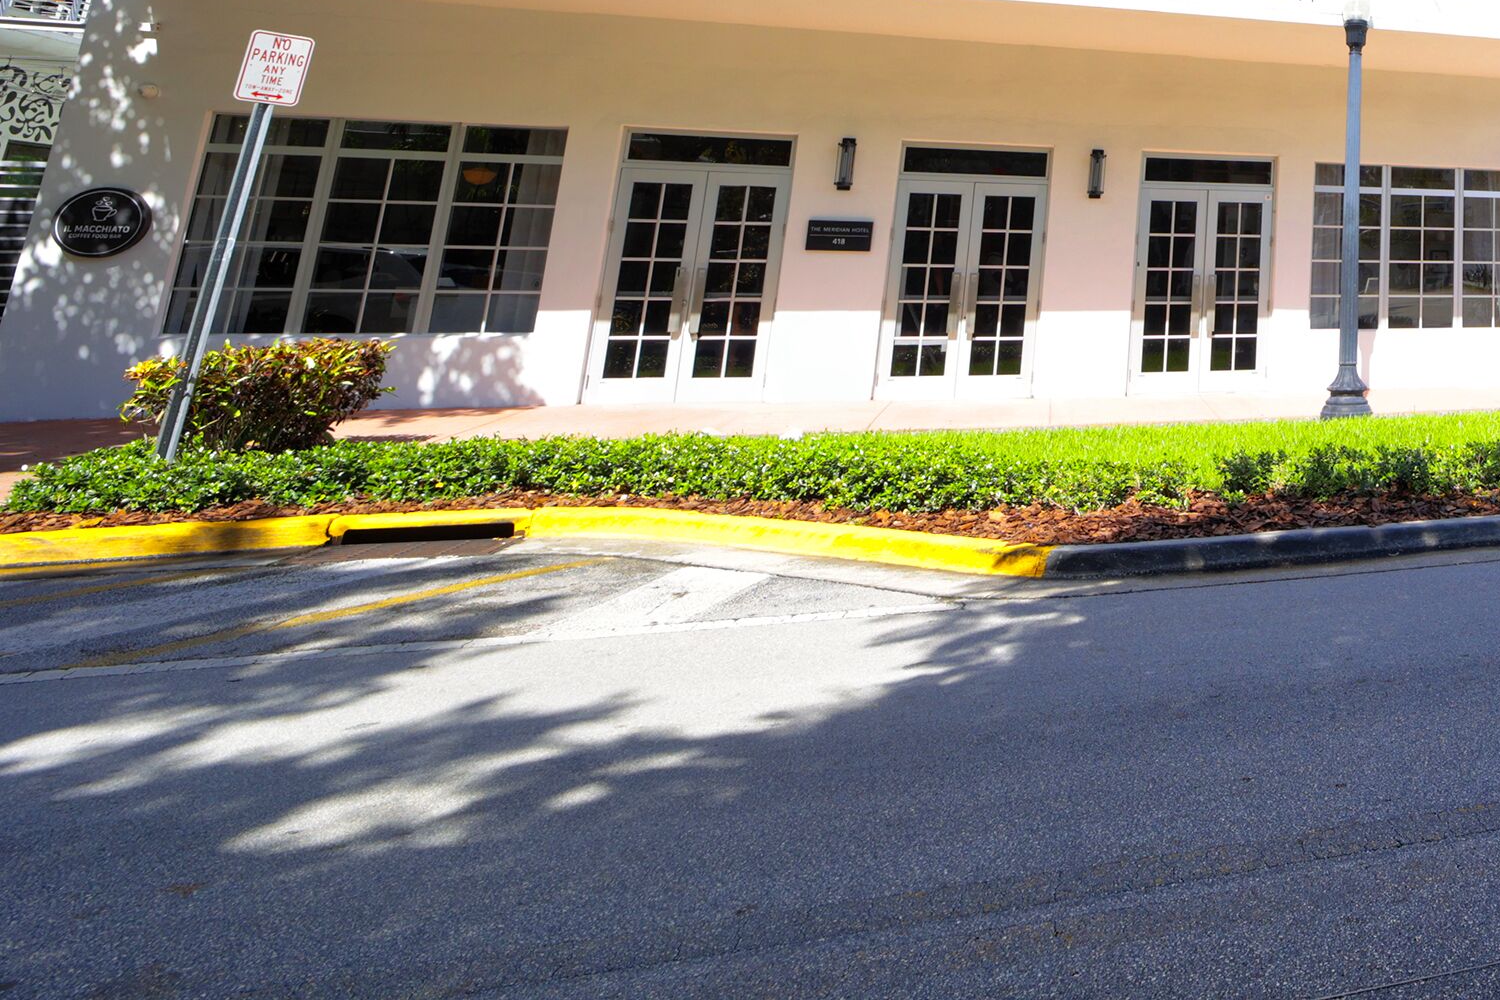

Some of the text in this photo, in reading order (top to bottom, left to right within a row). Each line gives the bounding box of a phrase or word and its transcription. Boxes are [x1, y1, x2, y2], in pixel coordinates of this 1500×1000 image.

[272, 37, 292, 51] NO
[251, 48, 305, 67] PARKING
[263, 65, 286, 75] ANY
[261, 75, 284, 86] TIME
[63, 225, 130, 233] IL MACCHIATO
